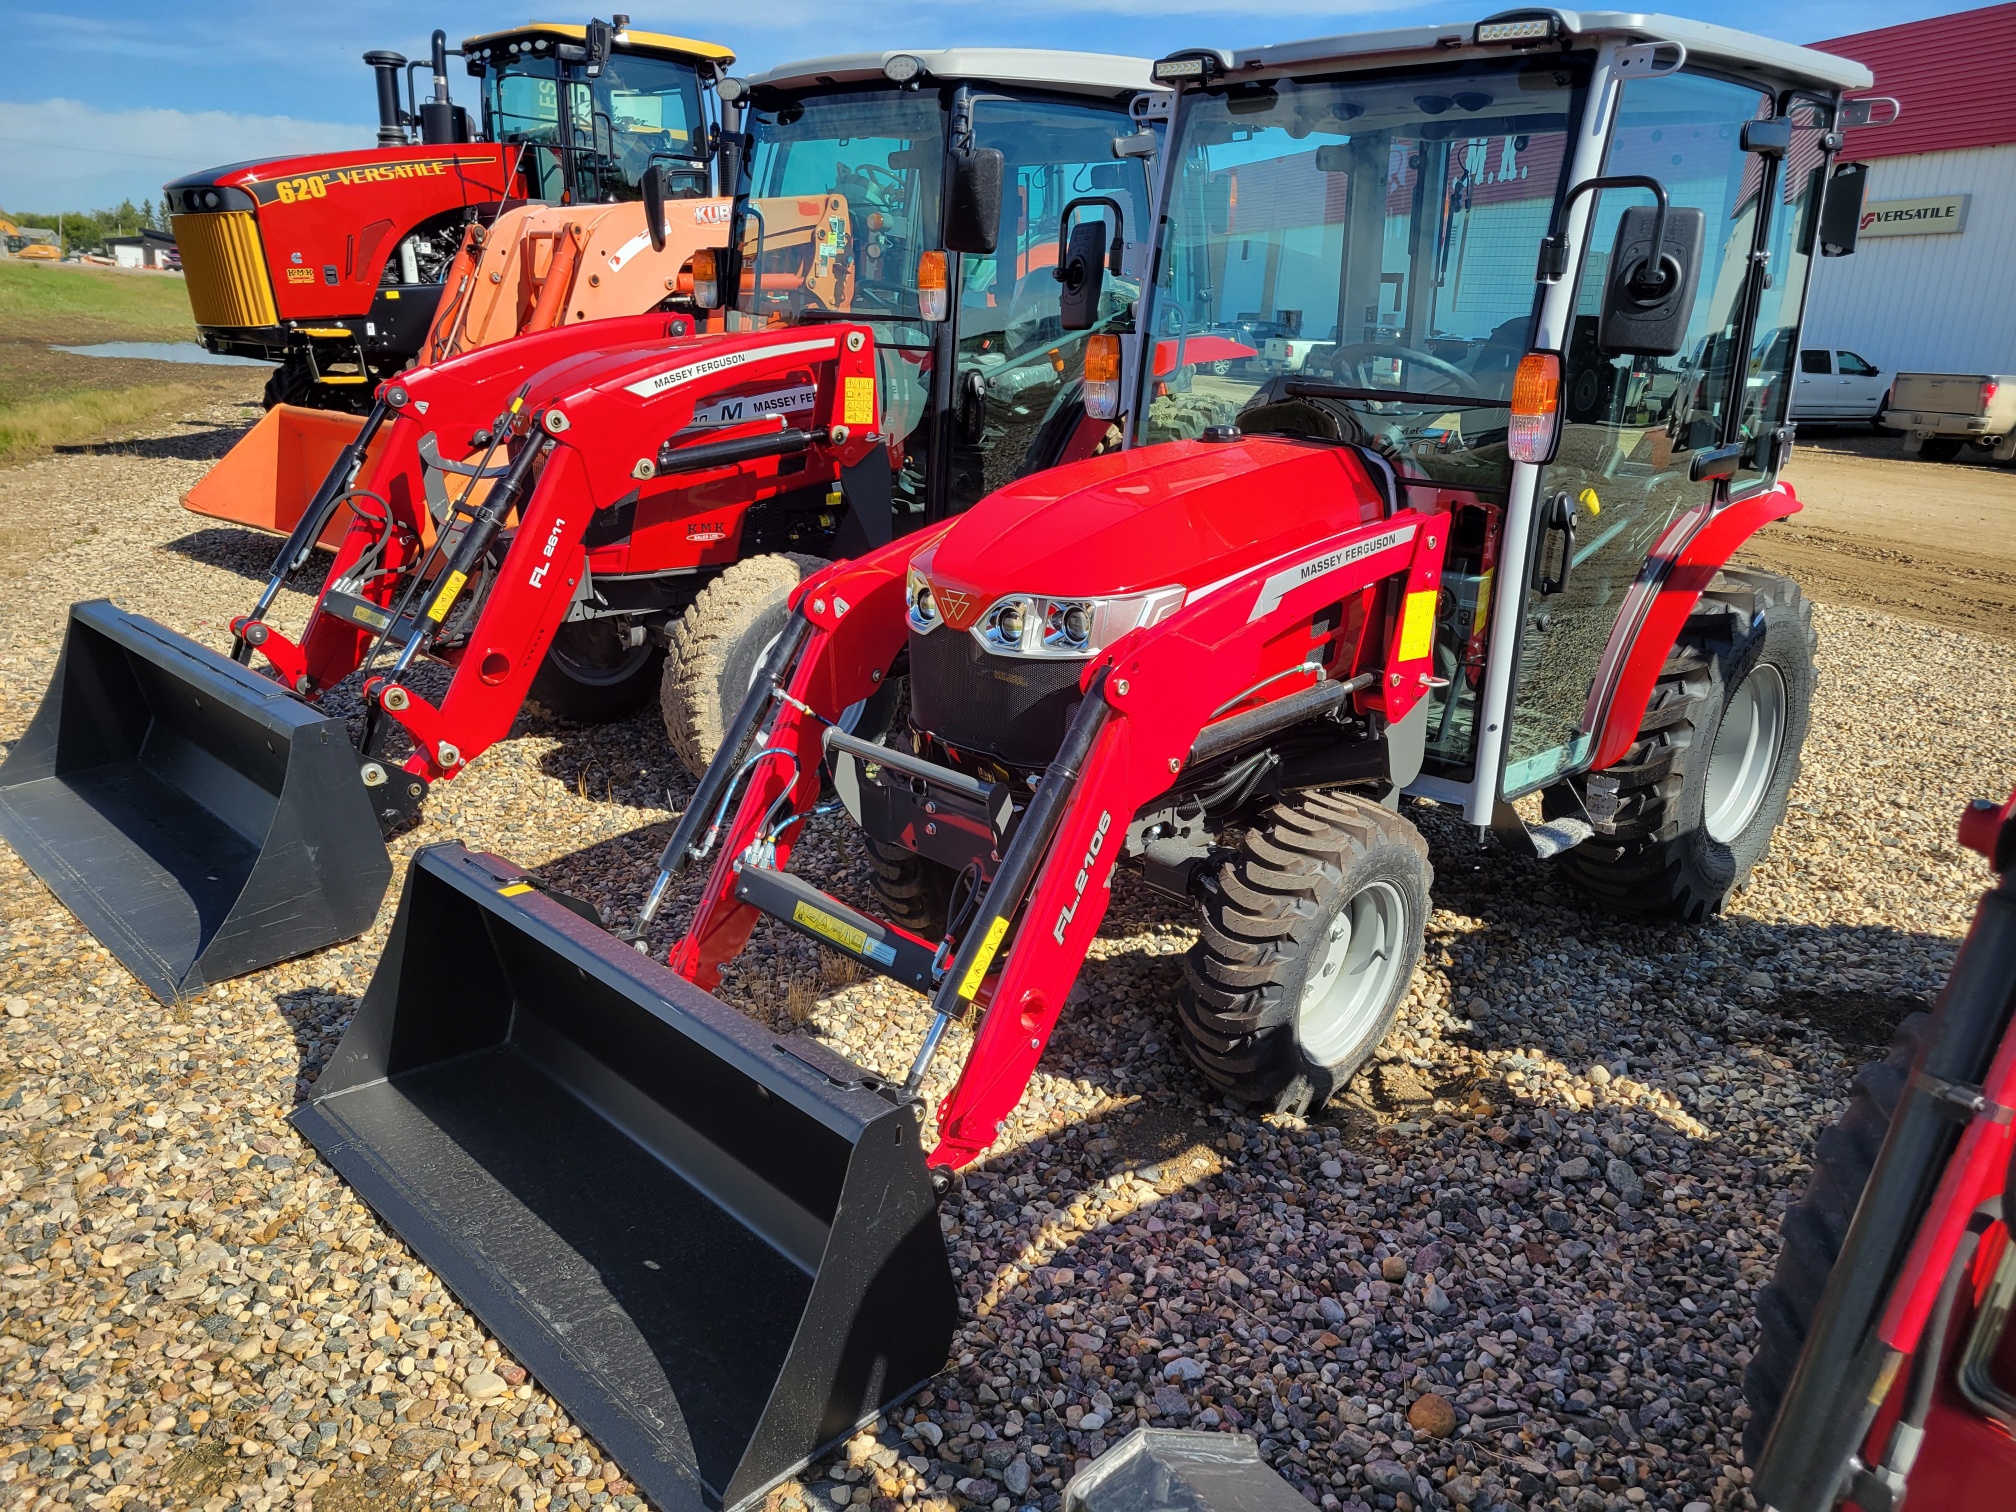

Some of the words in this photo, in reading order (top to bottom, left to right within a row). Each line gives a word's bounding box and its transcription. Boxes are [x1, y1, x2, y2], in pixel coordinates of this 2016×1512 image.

[276, 175, 327, 204] 620
[337, 161, 447, 185] VERSATILE
[1876, 206, 1957, 222] VERSATILE
[654, 367, 693, 389] MASSEY
[696, 353, 746, 375] FERGUSON
[721, 402, 743, 420] M
[753, 395, 796, 413] MASSEY
[529, 562, 551, 588] FL
[543, 518, 566, 558] 2611
[1301, 553, 1343, 579] MASSEY
[1345, 534, 1396, 561] FERGUSON
